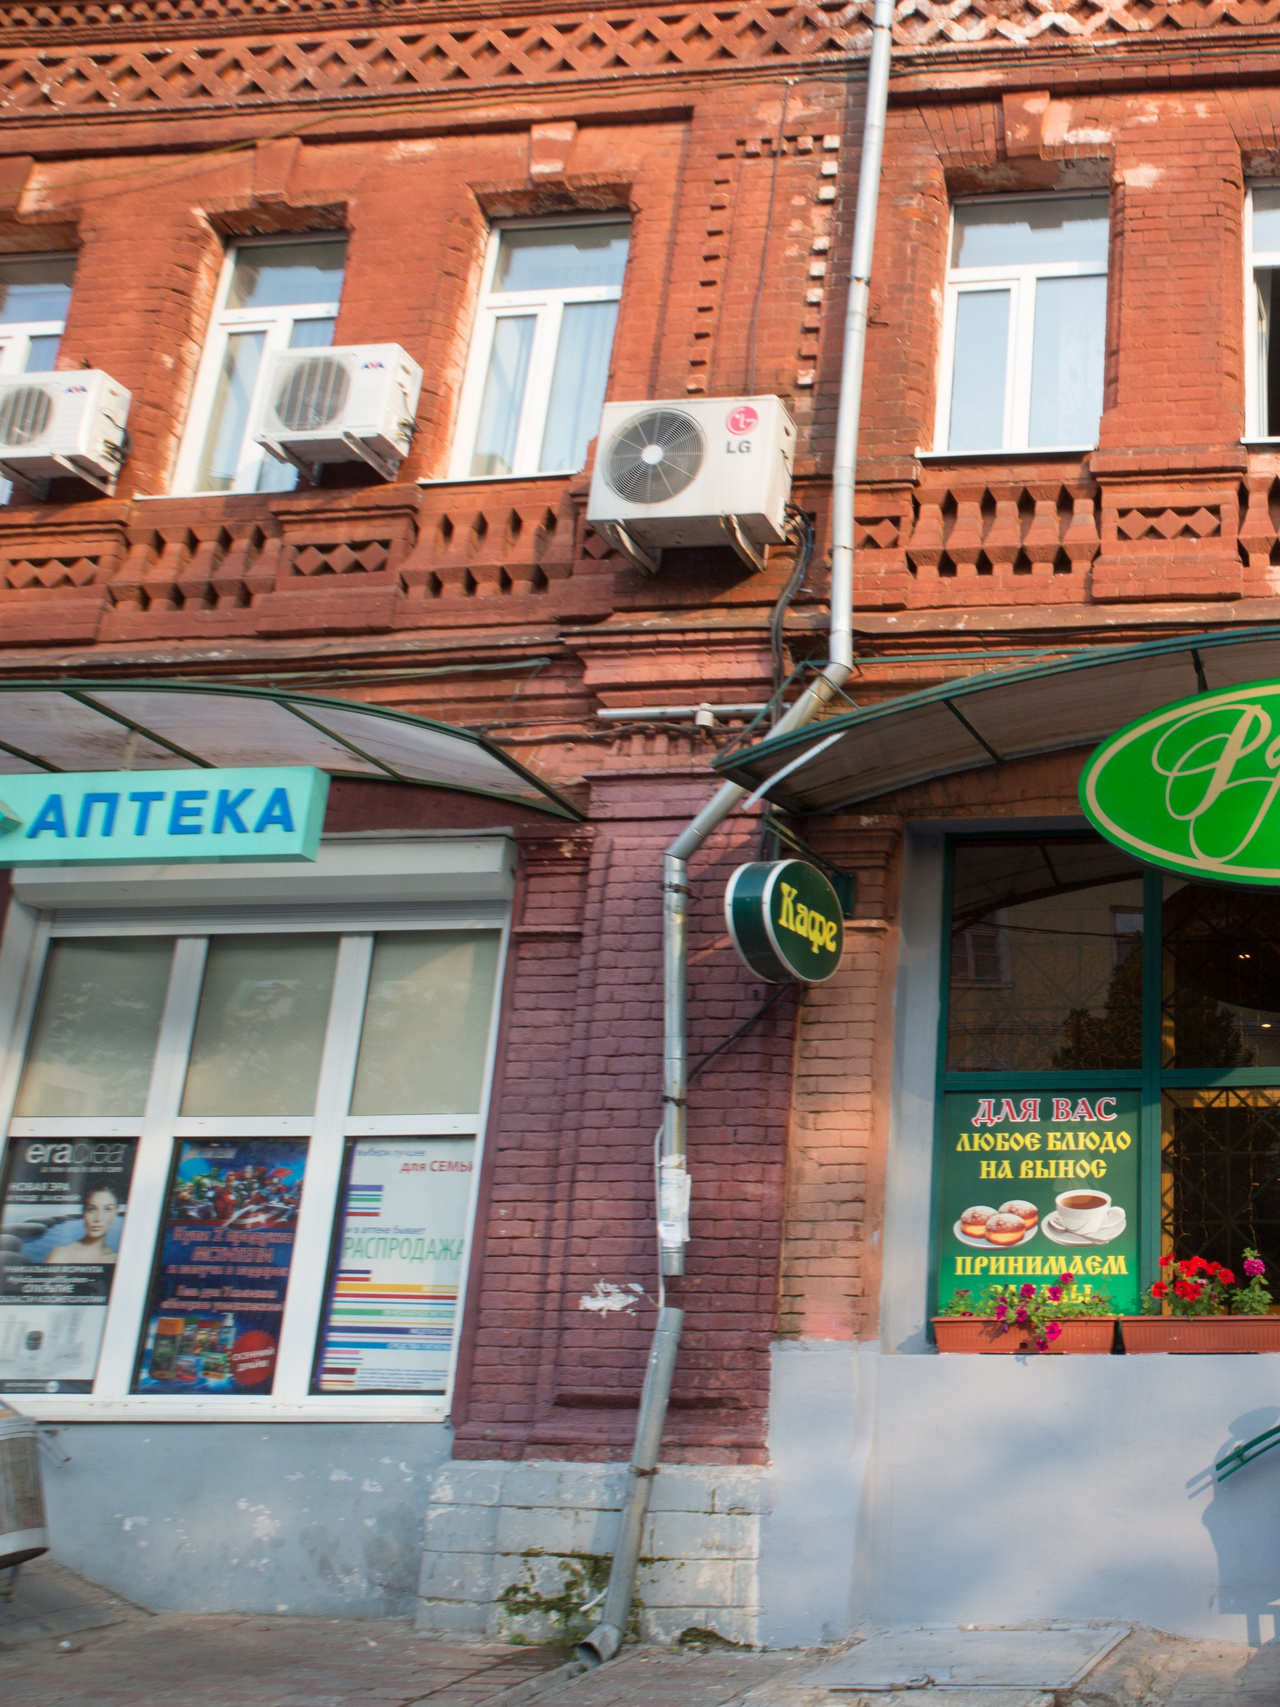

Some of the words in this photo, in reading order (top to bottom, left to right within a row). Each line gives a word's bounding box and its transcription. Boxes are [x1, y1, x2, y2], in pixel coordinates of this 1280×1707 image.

[726, 440, 752, 454] LG
[27, 786, 296, 839] АПТЕКА
[777, 881, 838, 954] Кафе
[971, 1097, 1041, 1127] ДЛЯ
[1051, 1097, 1118, 1122] ВАС
[956, 1132, 1042, 1152] ЛЮБОЕ
[1046, 1130, 1132, 1154] БЛЮДО
[25, 1143, 128, 1164] eraclea
[400, 1163, 427, 1173] для
[979, 1160, 1014, 1179] НА
[1019, 1159, 1107, 1179] ВЫНОС
[211, 1227, 224, 1241] 2
[954, 1255, 1129, 1276] ПРИНИМАЕМ
